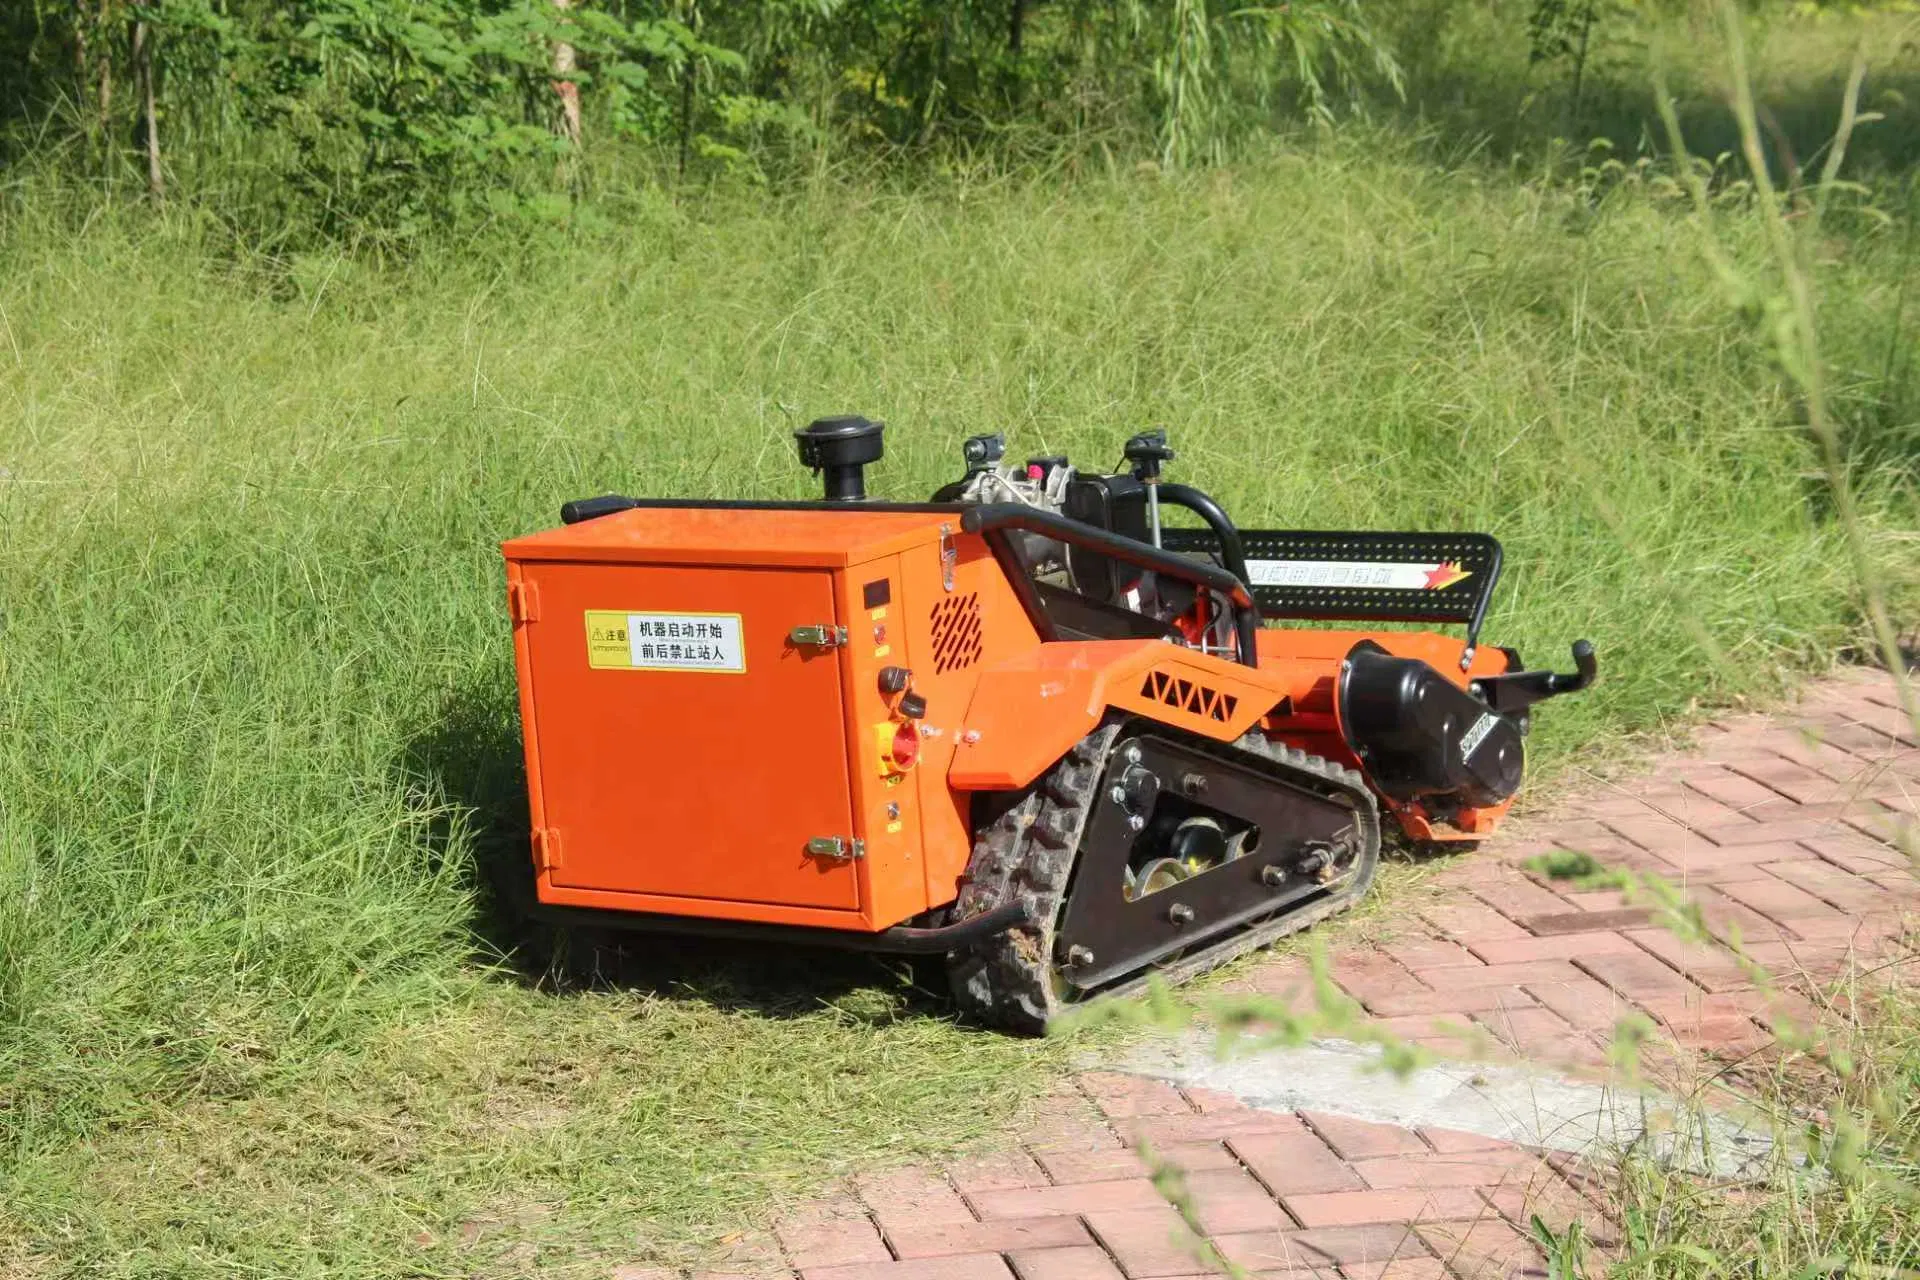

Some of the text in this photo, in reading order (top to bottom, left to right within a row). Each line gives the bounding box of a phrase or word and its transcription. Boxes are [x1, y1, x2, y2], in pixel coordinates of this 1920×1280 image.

[606, 629, 625, 642] 注意
[639, 621, 723, 639] 机器启动开始
[641, 643, 724, 660] 前后禁止站人
